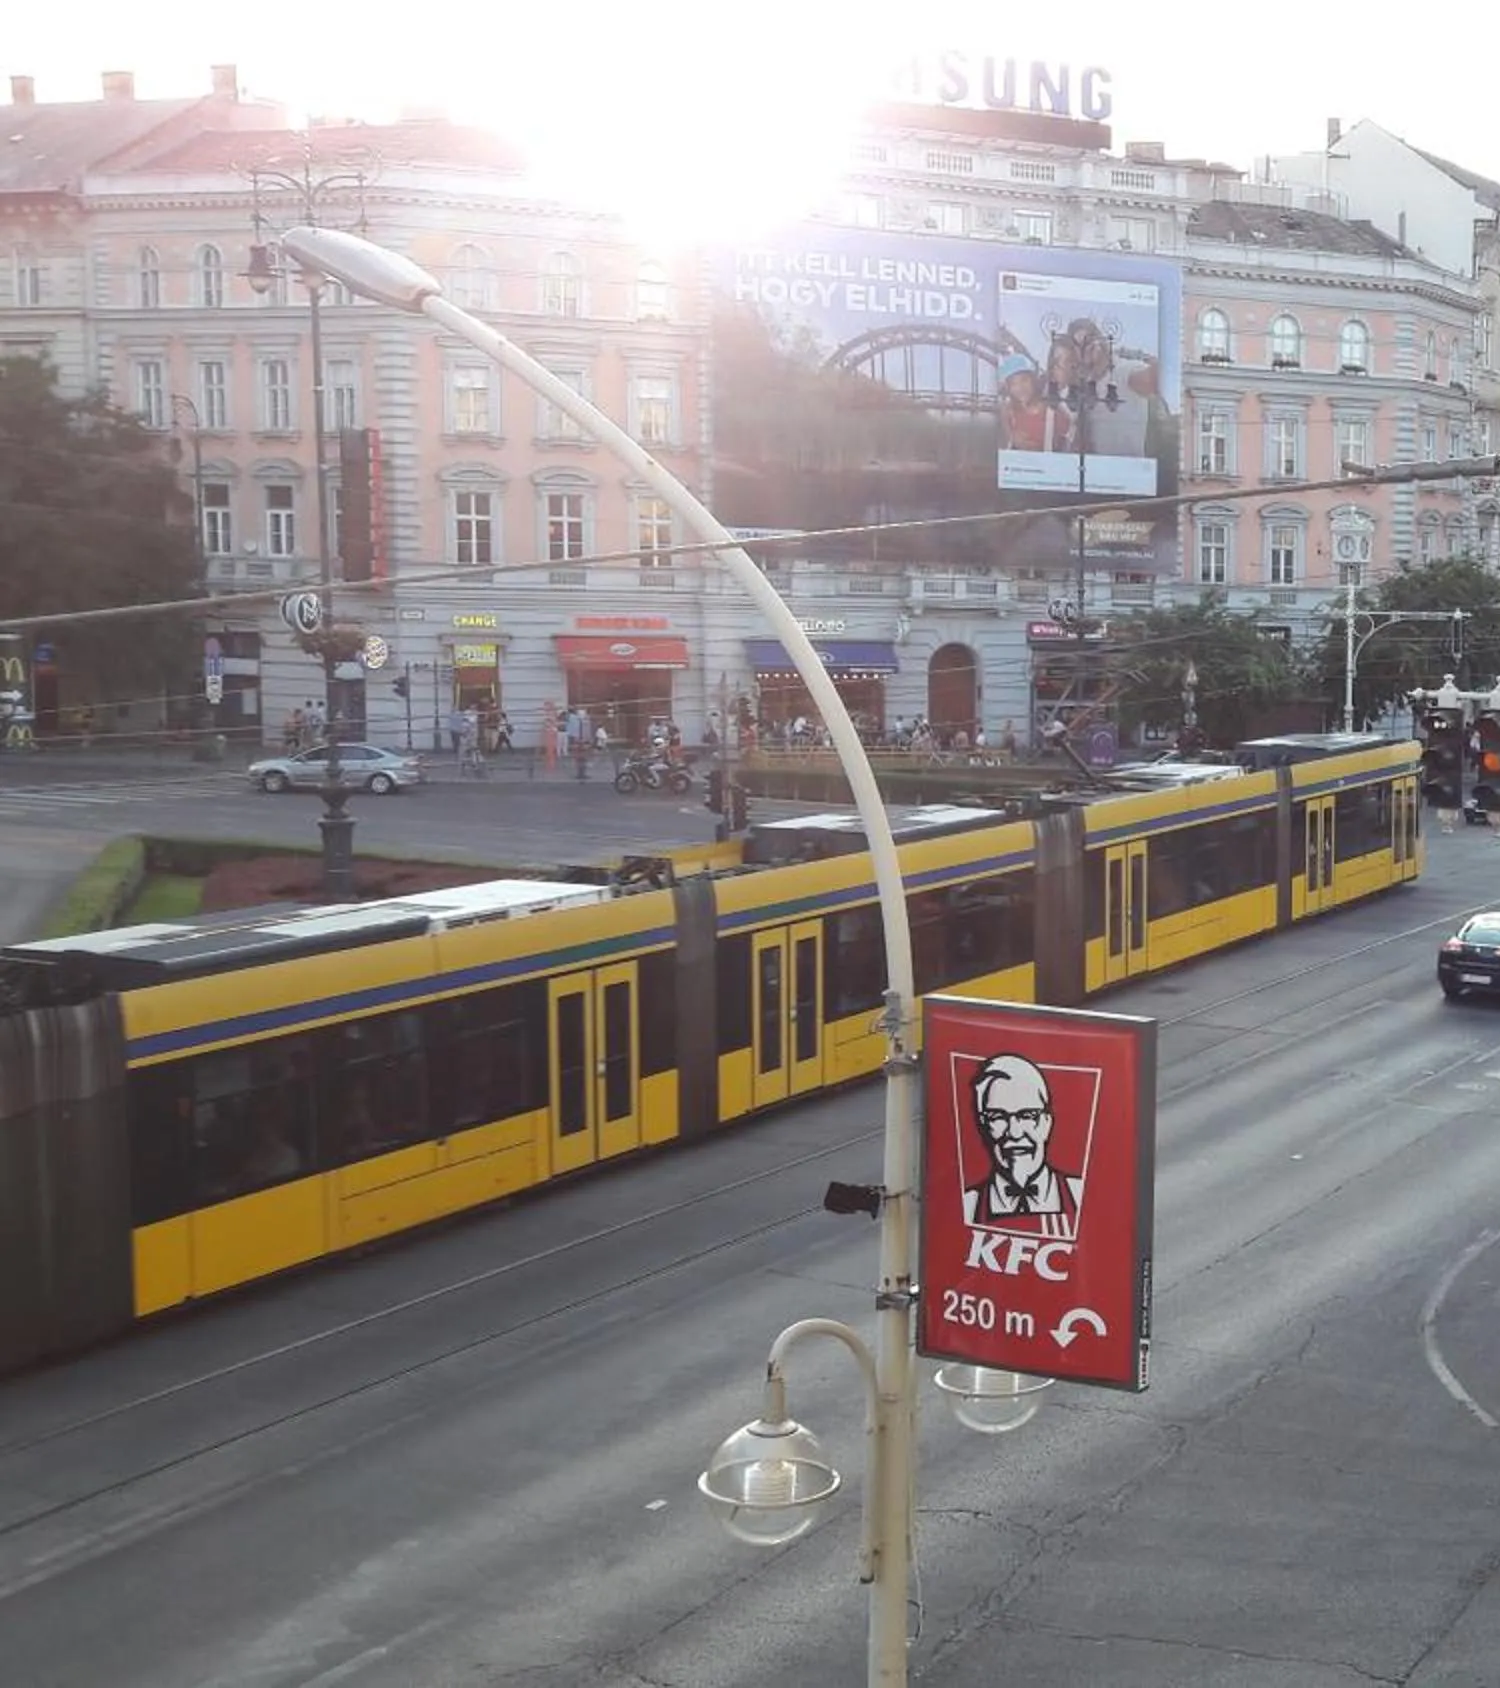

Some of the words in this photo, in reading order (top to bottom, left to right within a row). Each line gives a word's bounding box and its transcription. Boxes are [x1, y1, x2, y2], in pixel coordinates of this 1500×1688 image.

[892, 50, 1112, 120] SUNG
[785, 251, 856, 278] KELL
[861, 256, 982, 291] LENNED,
[735, 273, 840, 308] HOGY
[846, 283, 983, 321] ELHIDD.
[965, 1229, 1074, 1282] KFC
[943, 1289, 996, 1331] 250
[1004, 1309, 1036, 1338] m
